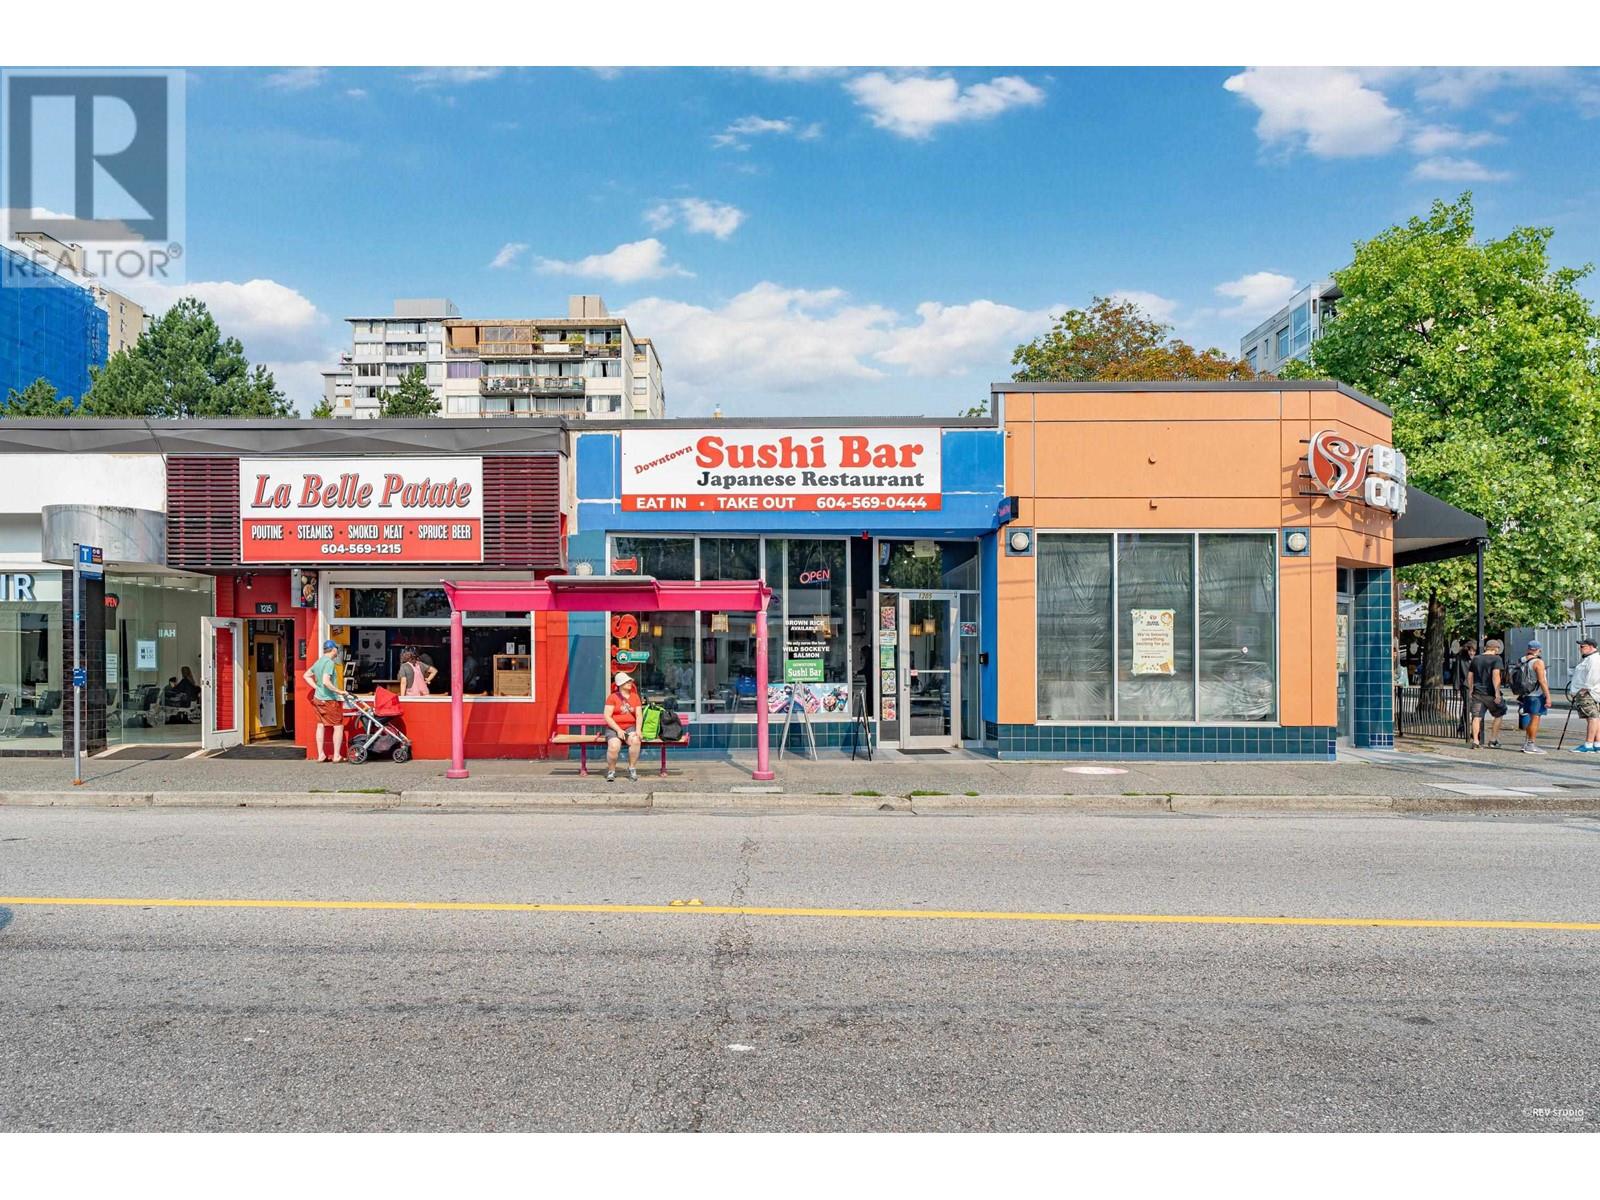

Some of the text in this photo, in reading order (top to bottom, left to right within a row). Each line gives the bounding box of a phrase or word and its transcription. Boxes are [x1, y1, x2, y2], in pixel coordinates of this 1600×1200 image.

[696, 435, 924, 469] Sushi Bar
[634, 445, 693, 475] Downtown
[697, 471, 925, 490] Japanese Restaurant
[251, 472, 472, 509] La Belle Patate
[636, 496, 927, 509] EAT IN TAKE OUT 604-569-0444
[251, 525, 472, 540] POUTINE STEAMIES SMOKED MEAT SPRUCE BEER
[321, 544, 402, 554] 604-569-1215
[800, 569, 830, 584] OPEN
[788, 667, 822, 677] Sushi Bar
